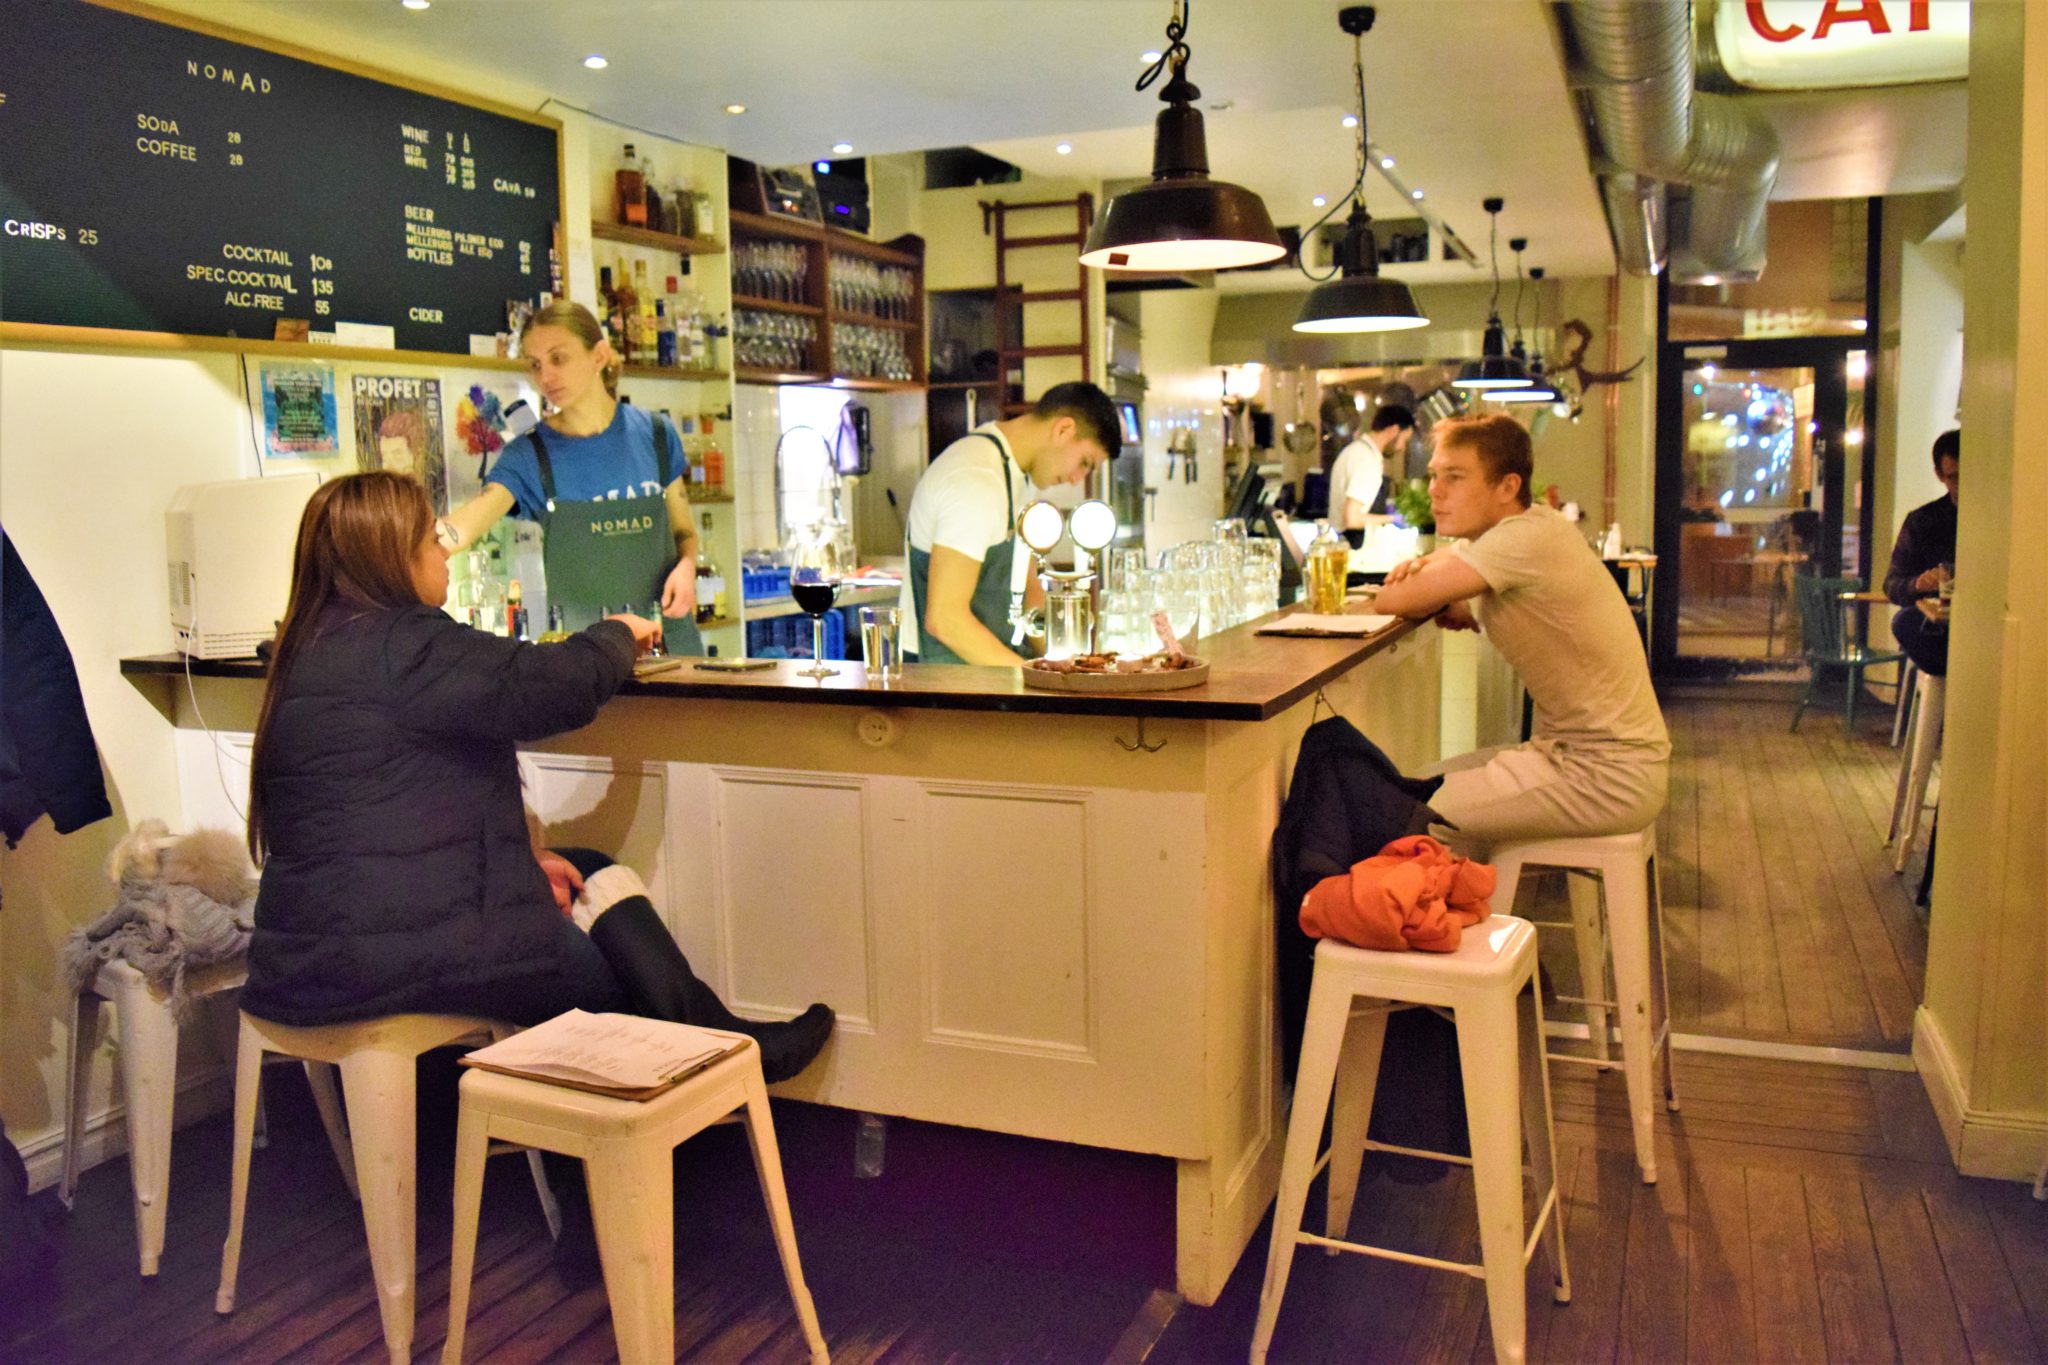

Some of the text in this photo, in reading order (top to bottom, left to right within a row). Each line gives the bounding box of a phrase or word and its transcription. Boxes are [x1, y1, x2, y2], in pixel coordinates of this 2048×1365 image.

[187, 60, 271, 93] NOMAD
[401, 124, 430, 145] WINE
[136, 137, 197, 162] COFFEE
[493, 178, 522, 197] CAVA
[404, 203, 434, 223] BEER
[78, 229, 98, 245] 25
[222, 243, 293, 267] COCKTAIL
[407, 247, 454, 266] BOTTLES
[312, 277, 334, 296] 135
[314, 299, 330, 315] 55
[408, 307, 444, 324] CIDER
[354, 375, 422, 399] PROFET
[591, 515, 654, 535] NOMAD
